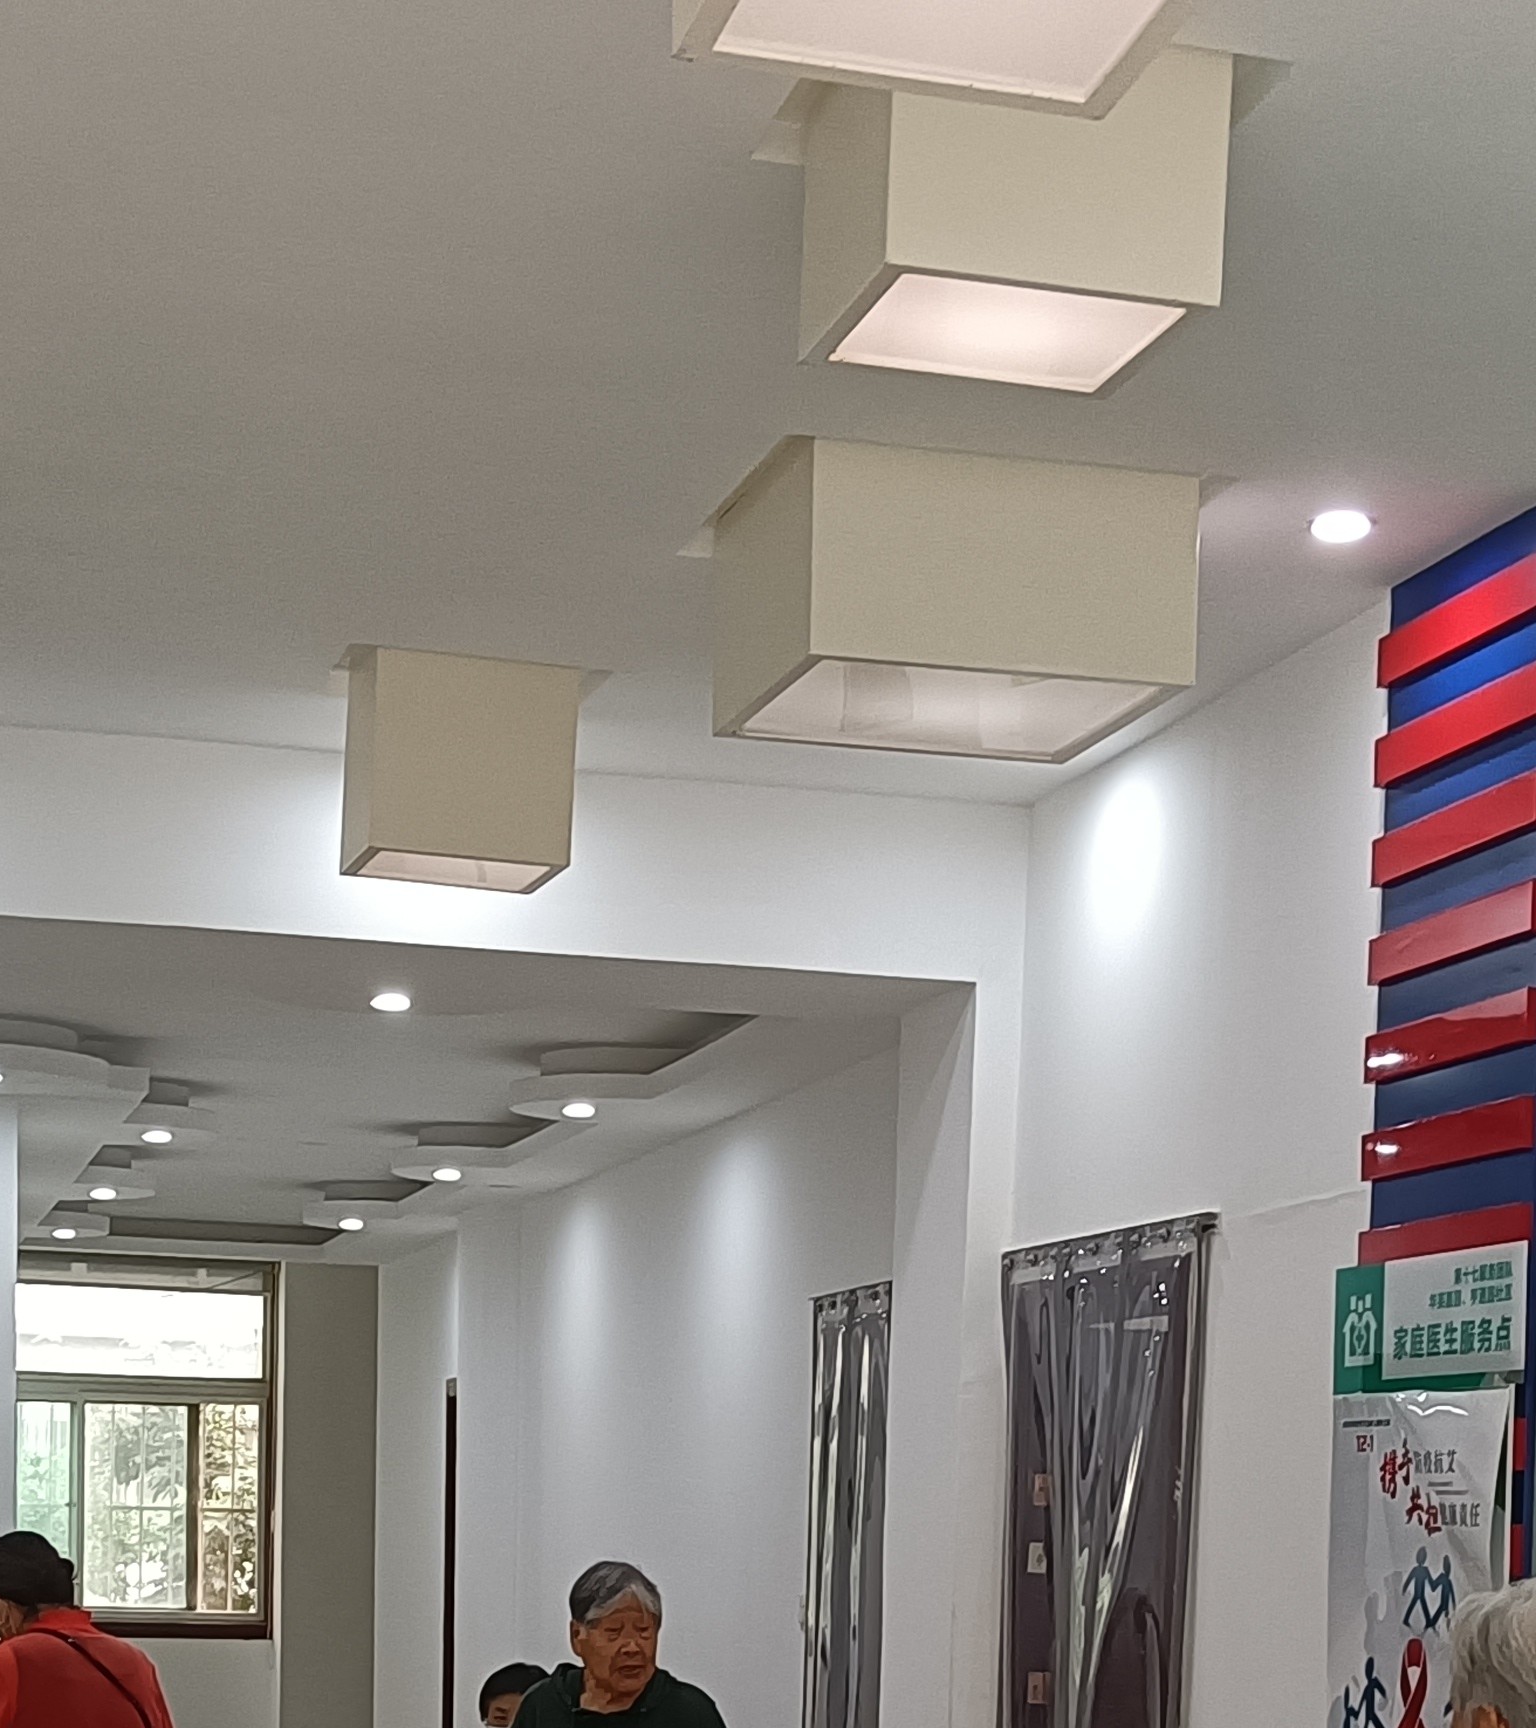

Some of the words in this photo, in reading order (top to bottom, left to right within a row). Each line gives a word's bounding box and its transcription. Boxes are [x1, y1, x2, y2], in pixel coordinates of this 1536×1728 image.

[1393, 1314, 1512, 1361] 家庭医生服务点
